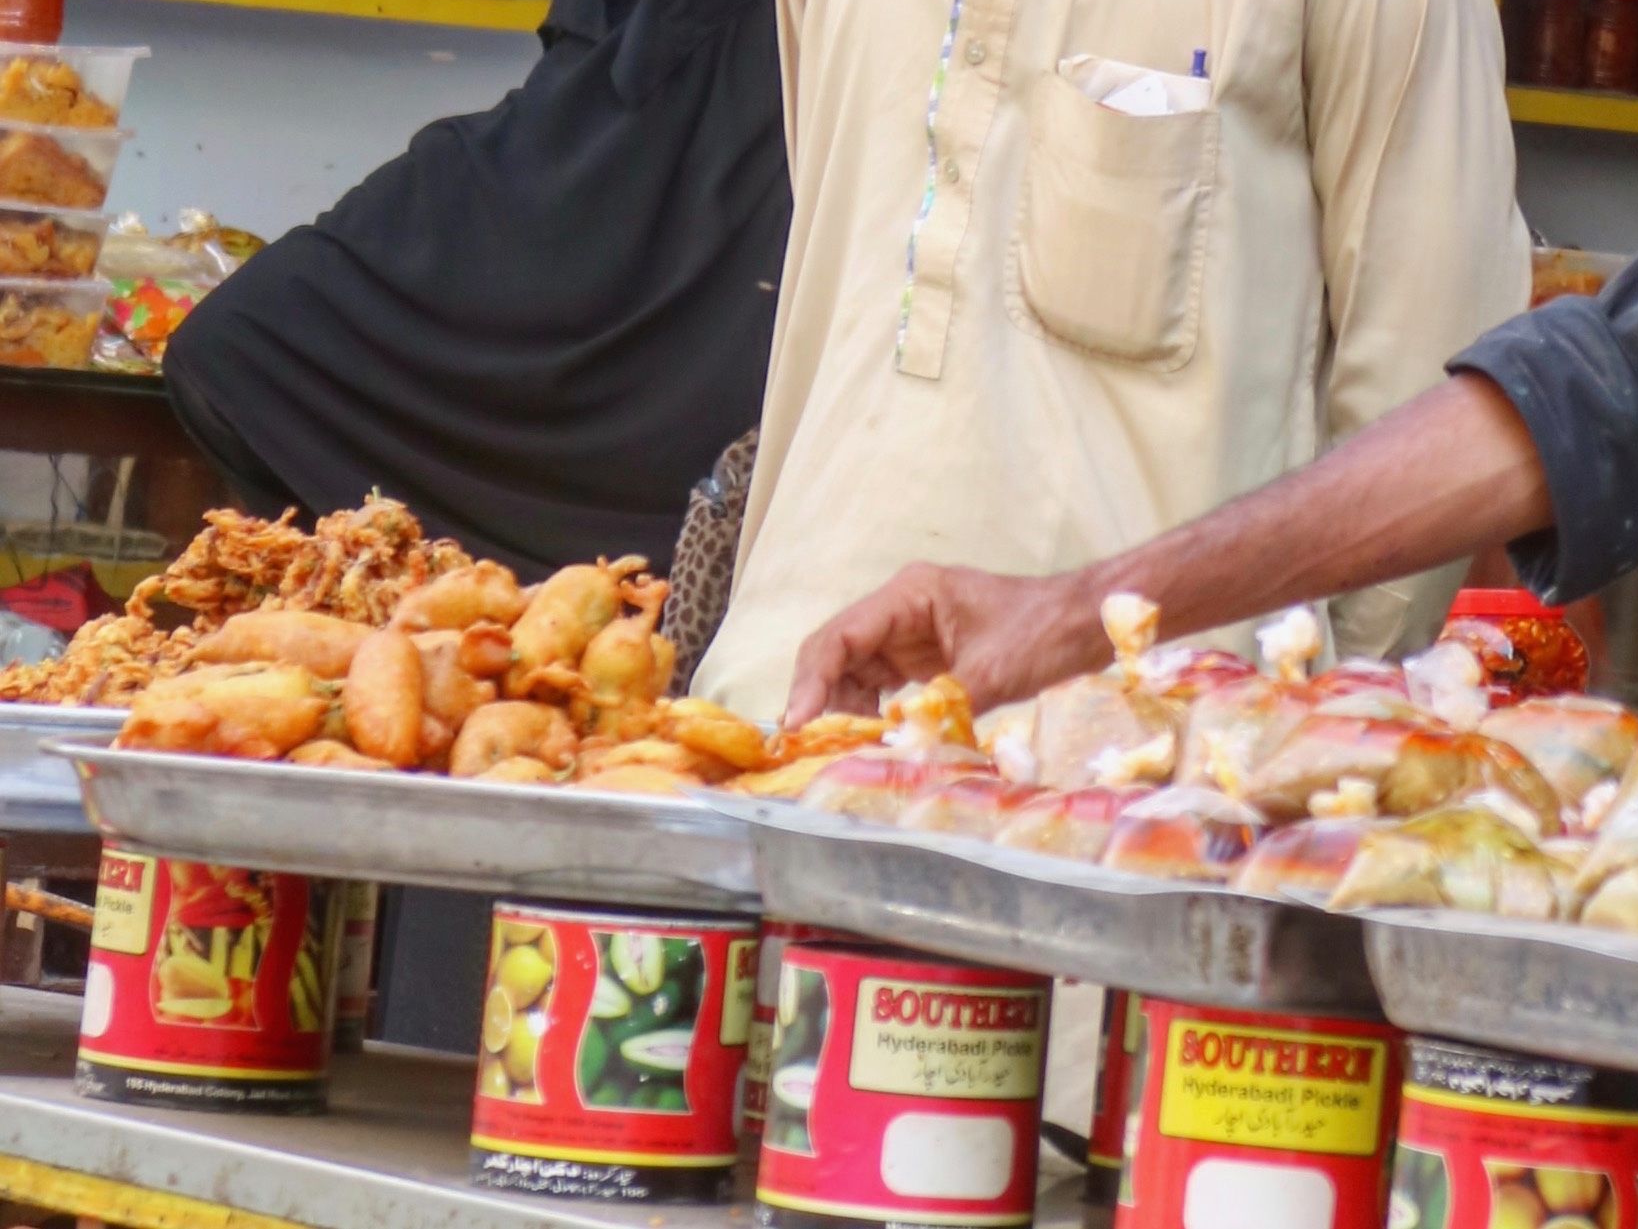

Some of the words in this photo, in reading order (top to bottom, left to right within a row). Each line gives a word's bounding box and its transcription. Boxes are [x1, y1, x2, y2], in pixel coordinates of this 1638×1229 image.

[876, 1032, 987, 1058] Hyderabadi
[1180, 1029, 1375, 1086] SOUTHERN
[1183, 1075, 1293, 1104] Hyderabadi
[1301, 1087, 1361, 1111] Pickle
